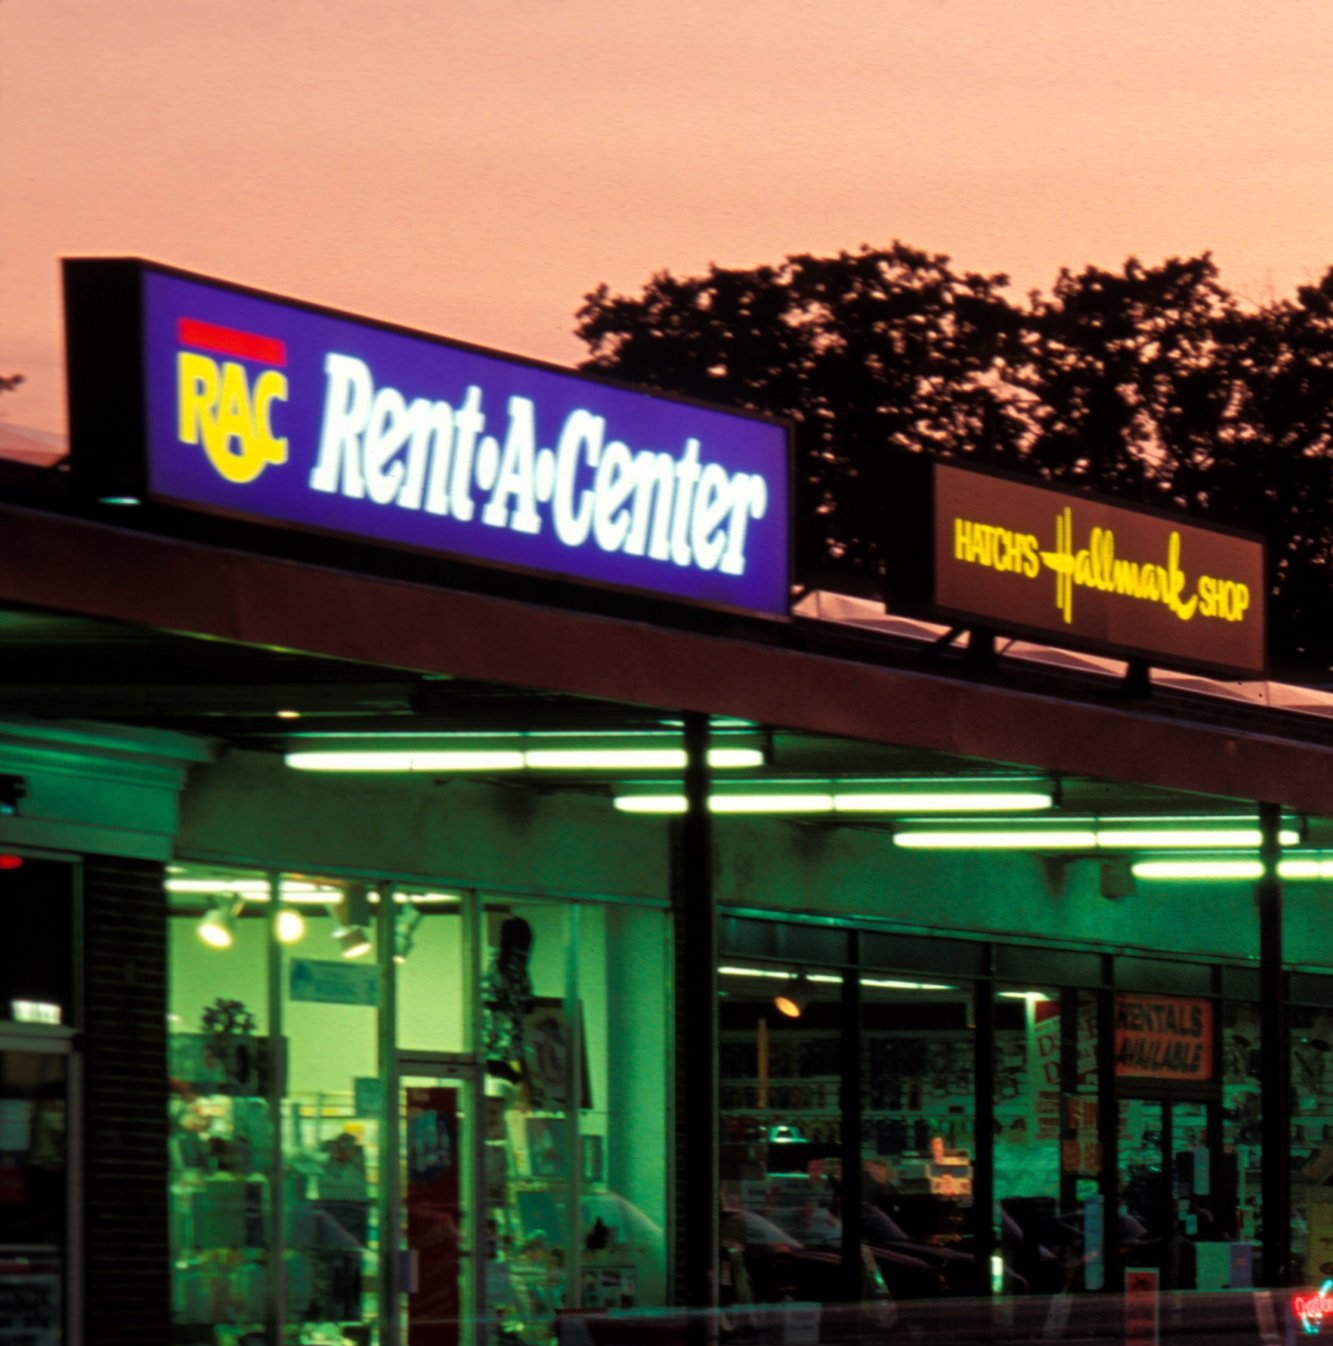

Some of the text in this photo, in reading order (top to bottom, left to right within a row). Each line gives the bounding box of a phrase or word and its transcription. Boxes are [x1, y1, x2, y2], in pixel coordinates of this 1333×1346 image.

[177, 351, 288, 483] RAC
[1040, 506, 1199, 624] Hallmark
[1198, 574, 1250, 622] SHOP
[1115, 1002, 1203, 1038] RENTALS
[1115, 1038, 1203, 1074] AVAILABLE
